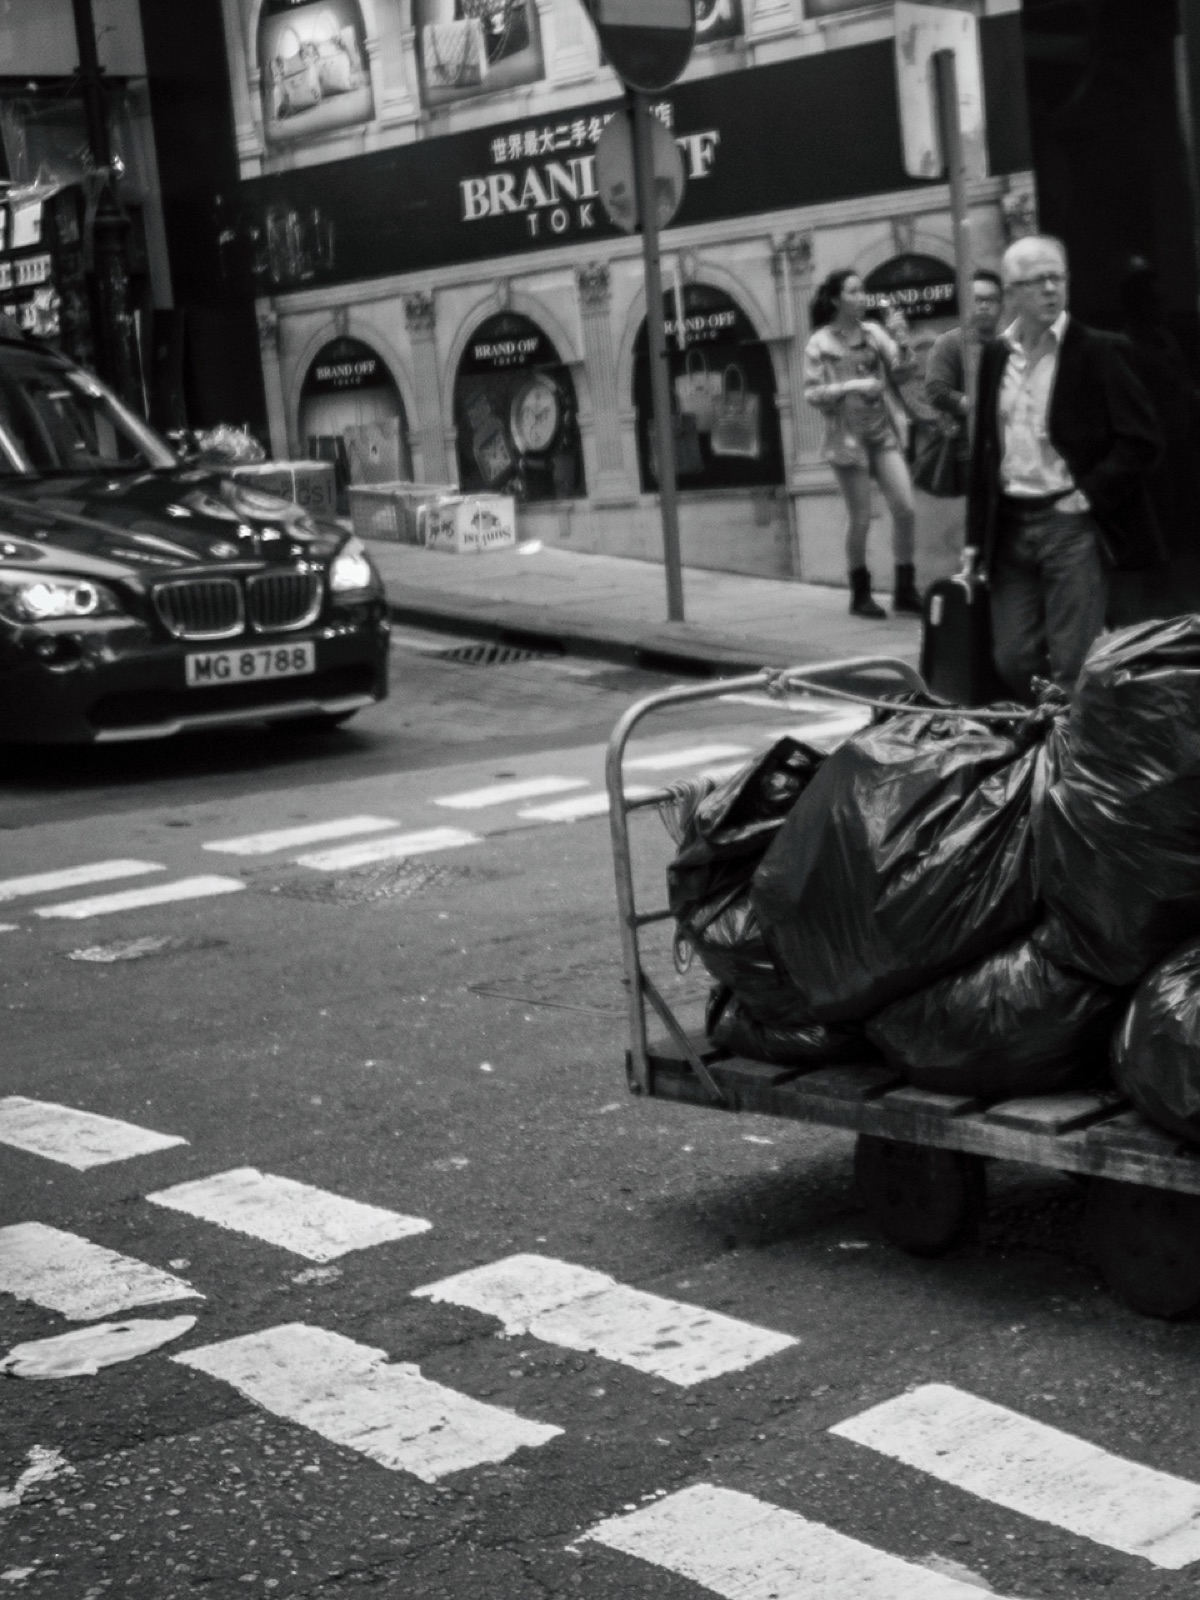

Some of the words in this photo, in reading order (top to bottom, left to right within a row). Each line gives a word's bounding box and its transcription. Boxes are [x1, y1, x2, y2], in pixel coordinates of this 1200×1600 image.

[526, 203, 594, 237] TOK
[922, 283, 955, 302] OFF
[708, 311, 736, 329] OFF
[474, 341, 515, 360] BRAND
[315, 363, 352, 380] BRAND
[354, 360, 376, 375] OFF
[194, 654, 231, 681] MG
[239, 647, 307, 677] 8788
